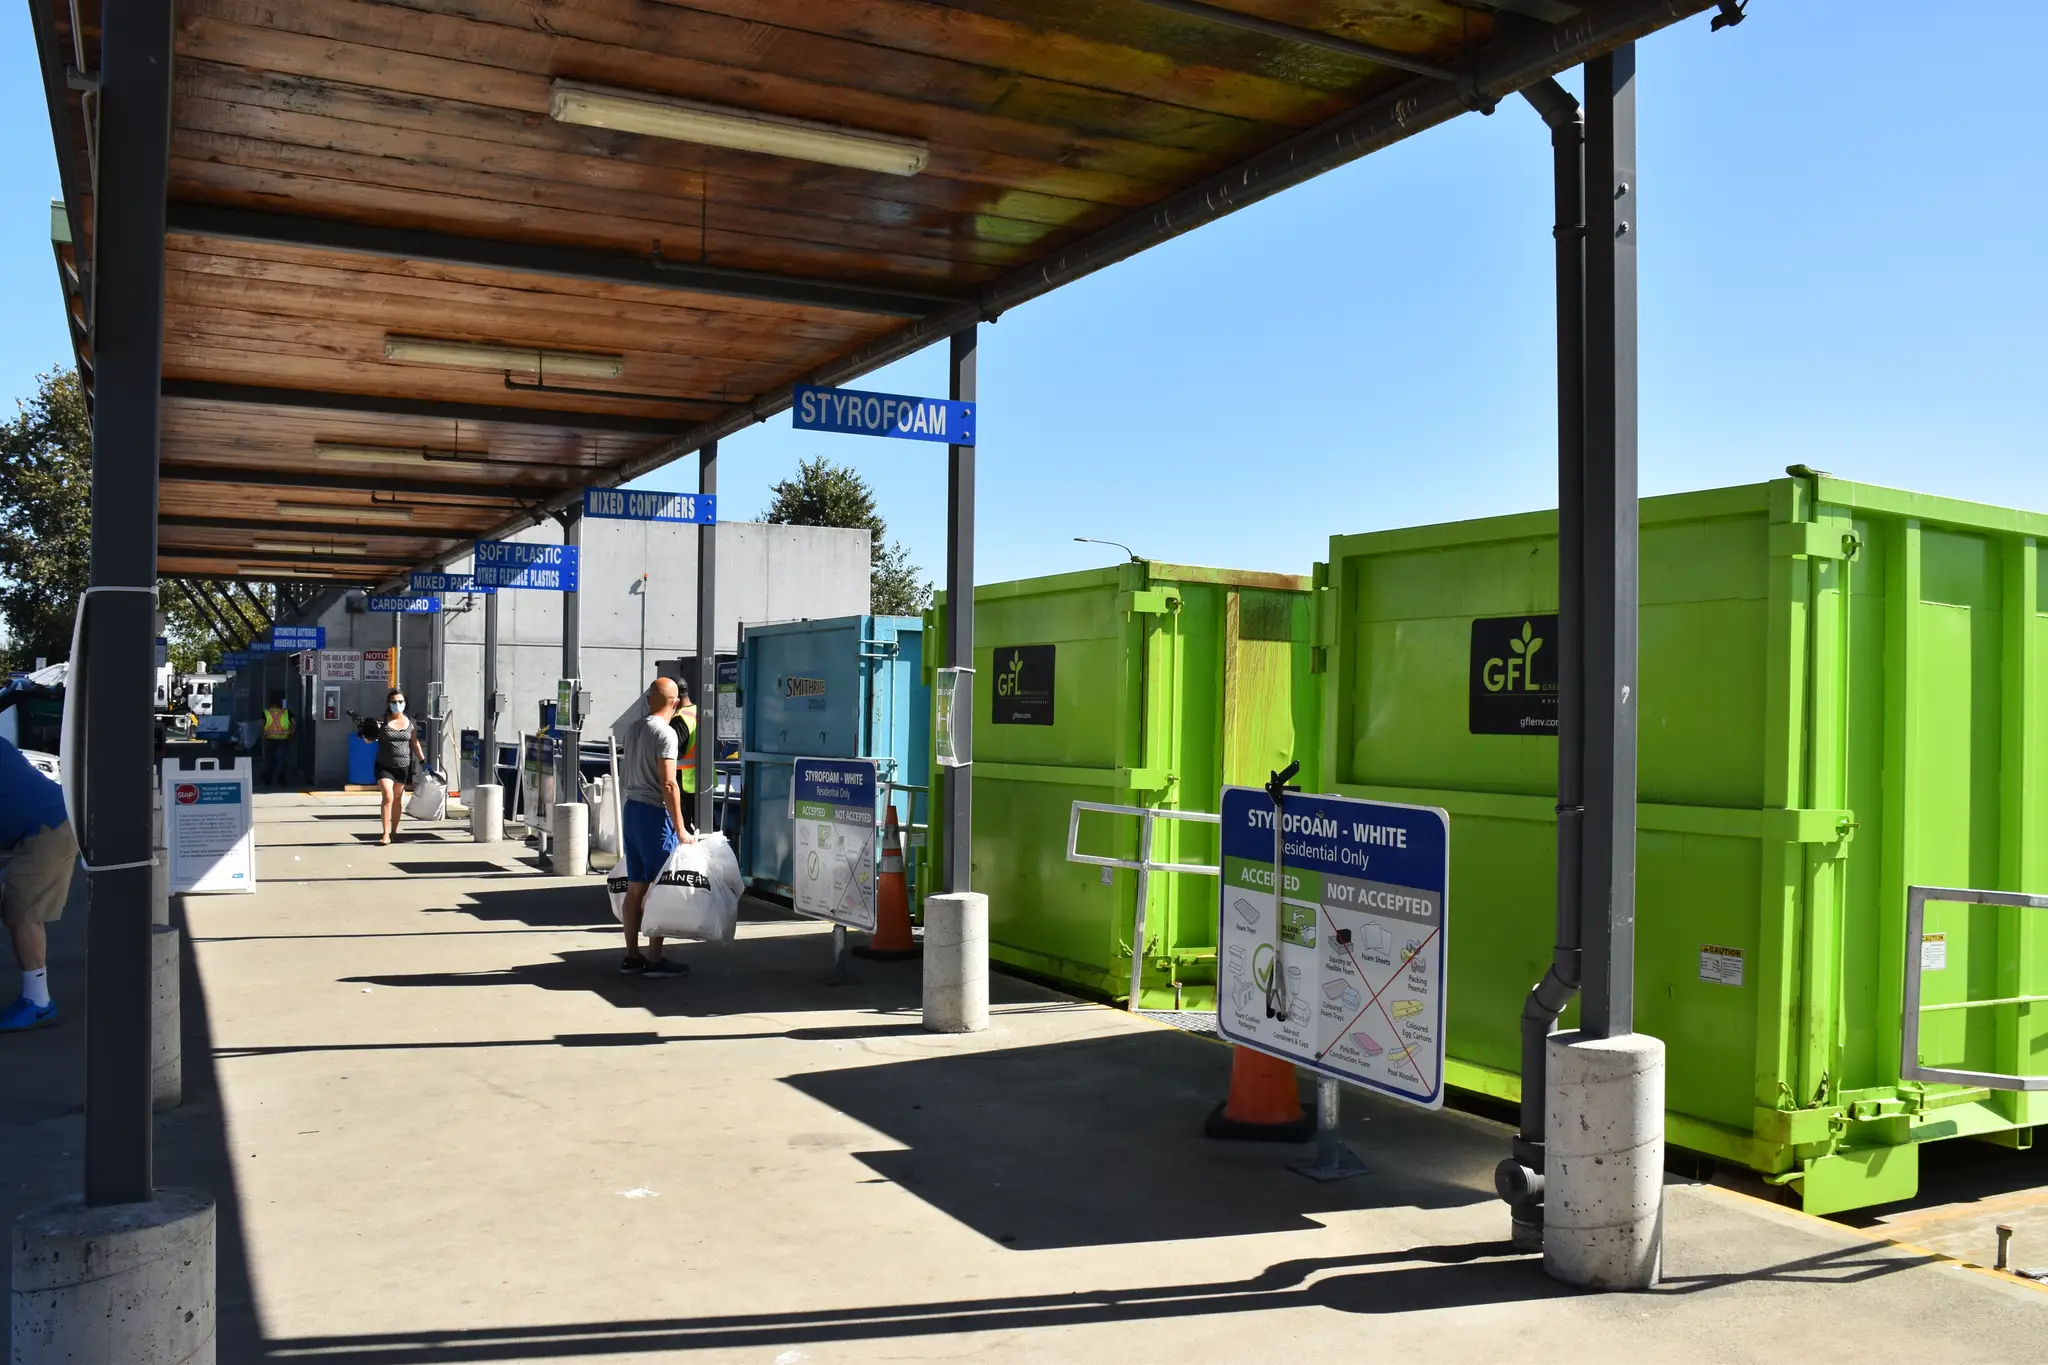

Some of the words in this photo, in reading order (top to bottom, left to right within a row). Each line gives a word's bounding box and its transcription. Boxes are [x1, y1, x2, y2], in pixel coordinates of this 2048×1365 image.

[801, 391, 947, 437] STYROFOAM
[589, 491, 624, 515] MIXED
[629, 493, 695, 519] CONTAINERS
[479, 543, 510, 562] SOFT
[515, 546, 562, 565] PLASTIC
[413, 575, 446, 589] MIXED
[477, 567, 497, 585] OTHER
[499, 568, 528, 586] FLEXIBLE
[530, 569, 560, 588] PLASTICS
[371, 598, 429, 611] CARDBOARD
[1483, 637, 1543, 692] GFL
[997, 660, 1023, 696] GFL
[804, 770, 840, 784] STYROFOAM
[843, 773, 864, 786] WHITE
[177, 789, 197, 800] Stop!
[816, 785, 839, 798] Residential
[839, 788, 851, 800] Only
[802, 806, 826, 817] ACCEPTED
[834, 809, 845, 820] NOT
[845, 811, 872, 823] ACCEPTED
[1353, 822, 1407, 849] WHITE
[1341, 847, 1370, 871] Only
[1327, 882, 1355, 901] NOT
[1358, 890, 1432, 917] ACCEPTED
[1236, 923, 1247, 932] Foam
[1709, 946, 1742, 957] CAUTION
[1329, 955, 1346, 967] Squishy
[1361, 953, 1375, 962] Foam
[1375, 956, 1391, 966] Sheets
[1325, 963, 1342, 973] Flexible
[1342, 967, 1355, 976] Foam
[1408, 975, 1428, 987] Packing
[1408, 984, 1428, 994] Peanuts
[1322, 1001, 1343, 1013] Coloured
[1320, 1009, 1333, 1018] Foam
[1333, 1012, 1344, 1022] Trays
[1406, 1021, 1429, 1033] Coloured
[1402, 1029, 1412, 1039] Egg
[1412, 1032, 1432, 1043] Cartons
[1299, 1040, 1309, 1049] Cups
[1329, 1050, 1358, 1064] Construction
[1358, 1060, 1371, 1068] Foam
[1387, 1068, 1398, 1077] Pool
[1399, 1071, 1419, 1084] Noodles
